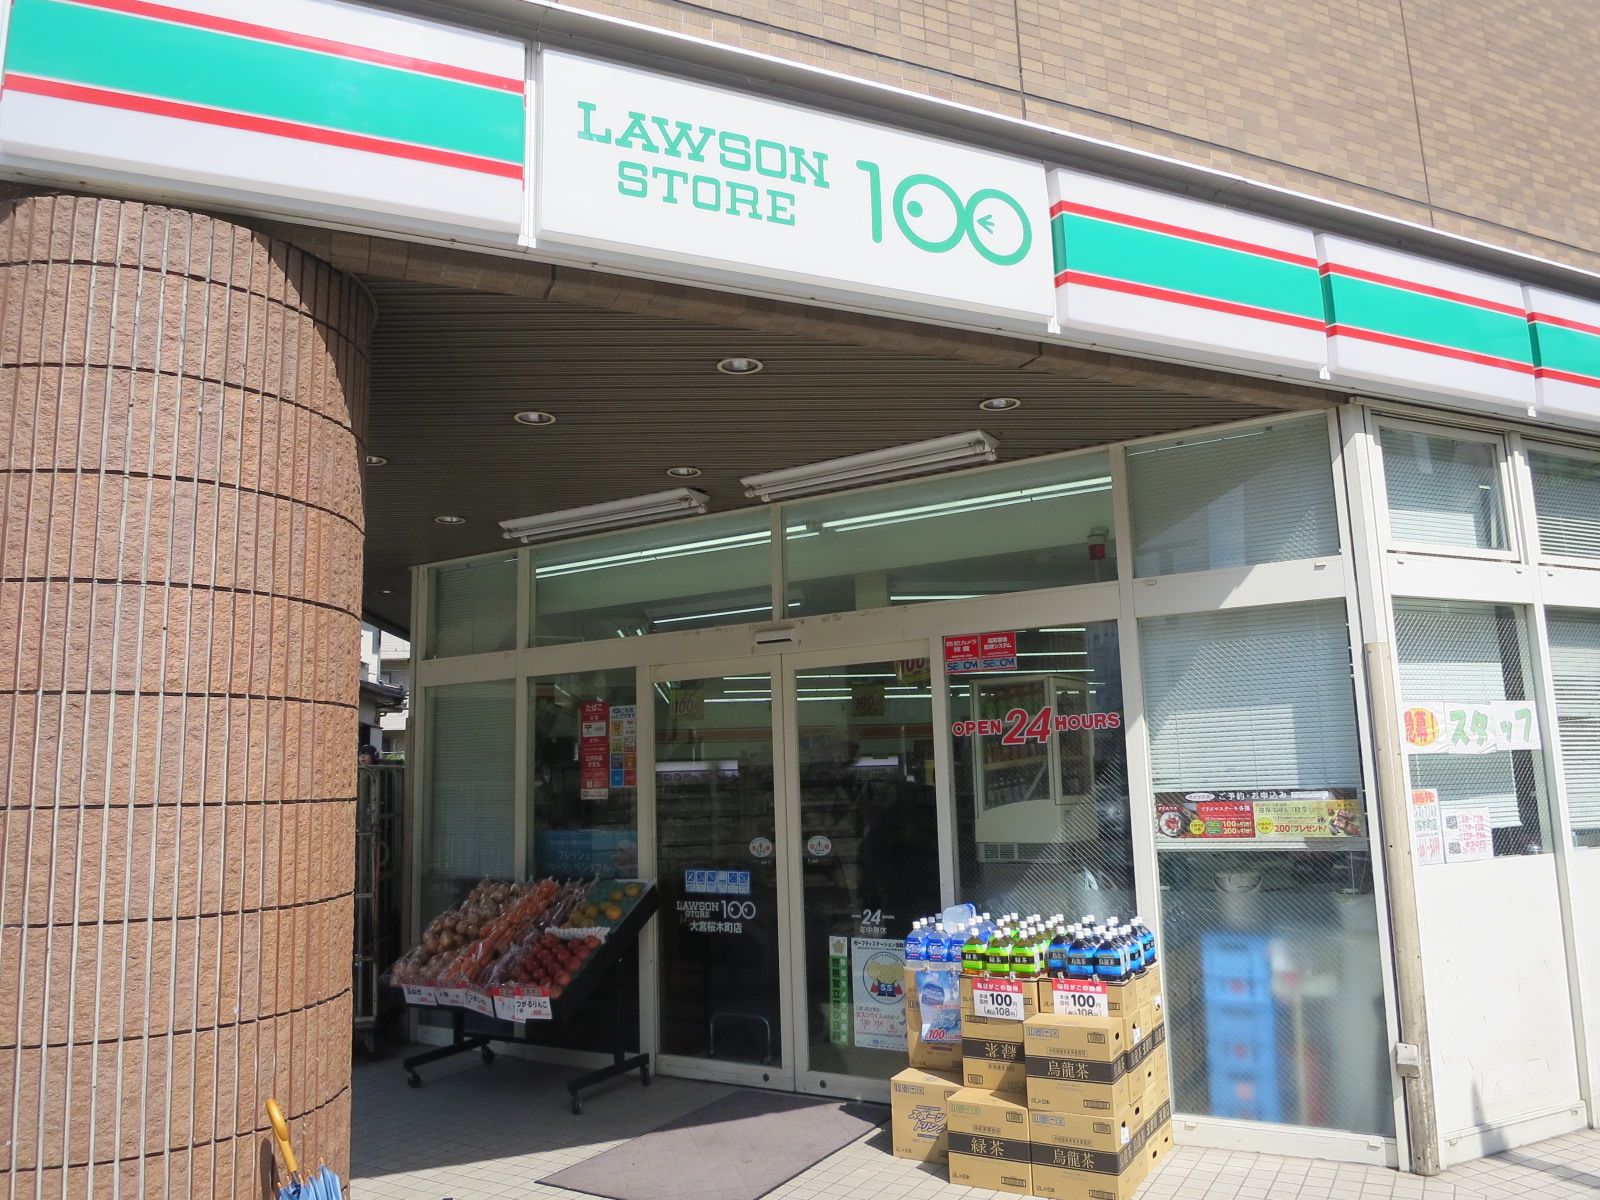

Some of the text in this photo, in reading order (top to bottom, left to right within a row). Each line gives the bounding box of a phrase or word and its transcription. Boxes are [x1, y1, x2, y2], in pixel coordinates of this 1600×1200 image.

[577, 100, 830, 189] LAWSON
[618, 160, 796, 227] STORE
[856, 159, 1032, 267] 100
[947, 662, 978, 671] SEOM
[952, 705, 1121, 745] OPEN 24 HOURS
[677, 900, 719, 912] LAWSON
[721, 900, 756, 919] 100
[862, 909, 882, 925] 24
[689, 921, 743, 934] 大宮桜木町店
[880, 984, 893, 992] SS
[1047, 1060, 1090, 1079] 烏龍茶
[908, 1109, 946, 1123] スポーツ
[912, 1120, 948, 1133] ドリンク
[970, 1137, 1005, 1157] 緑茶
[1053, 1149, 1095, 1169] 烏龍茶
